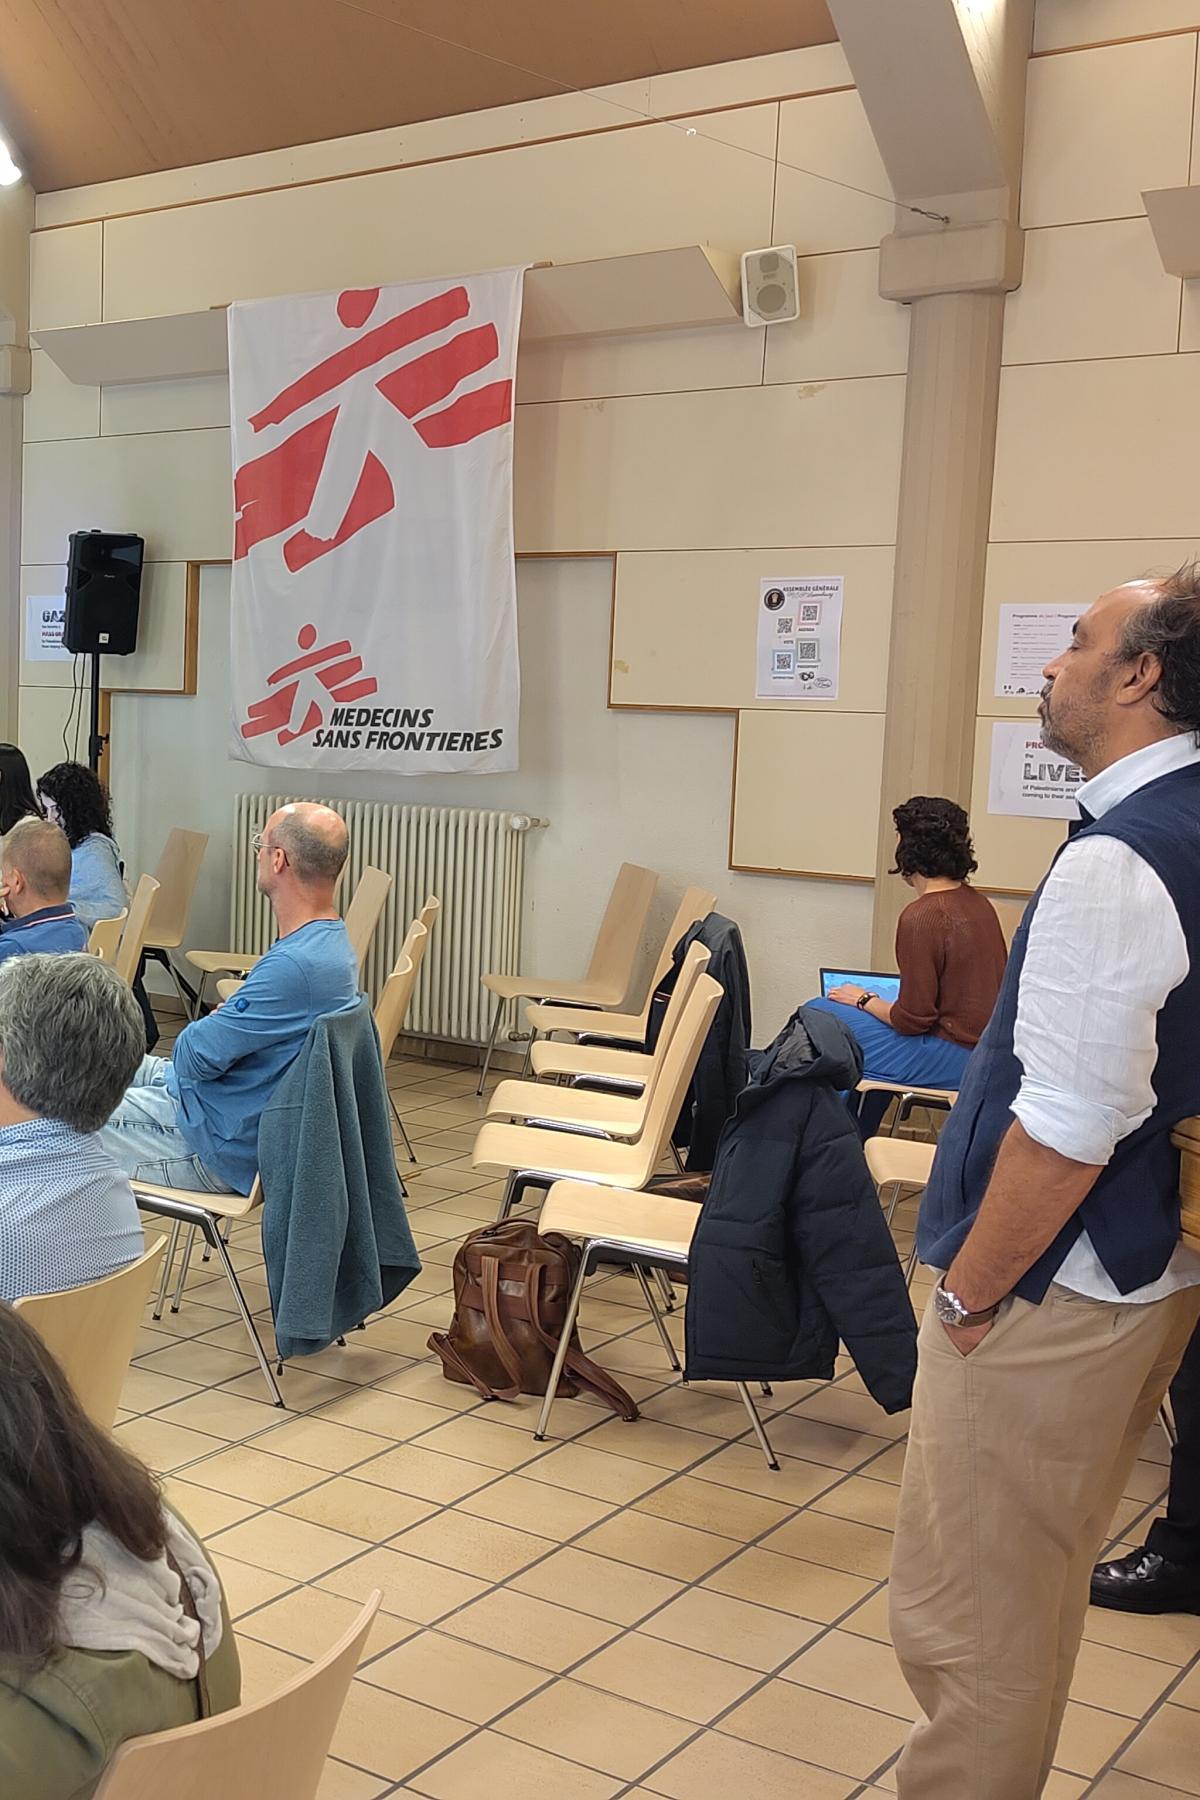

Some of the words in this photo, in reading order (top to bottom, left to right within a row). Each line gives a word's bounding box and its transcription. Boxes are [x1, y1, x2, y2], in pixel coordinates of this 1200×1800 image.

[42, 610, 65, 622] GAZ
[329, 707, 434, 729] MEDECINS
[312, 728, 362, 749] SANS
[364, 728, 504, 752] FRONTIERES
[1025, 741, 1045, 749] PRO
[1024, 763, 1088, 782] LIVE
